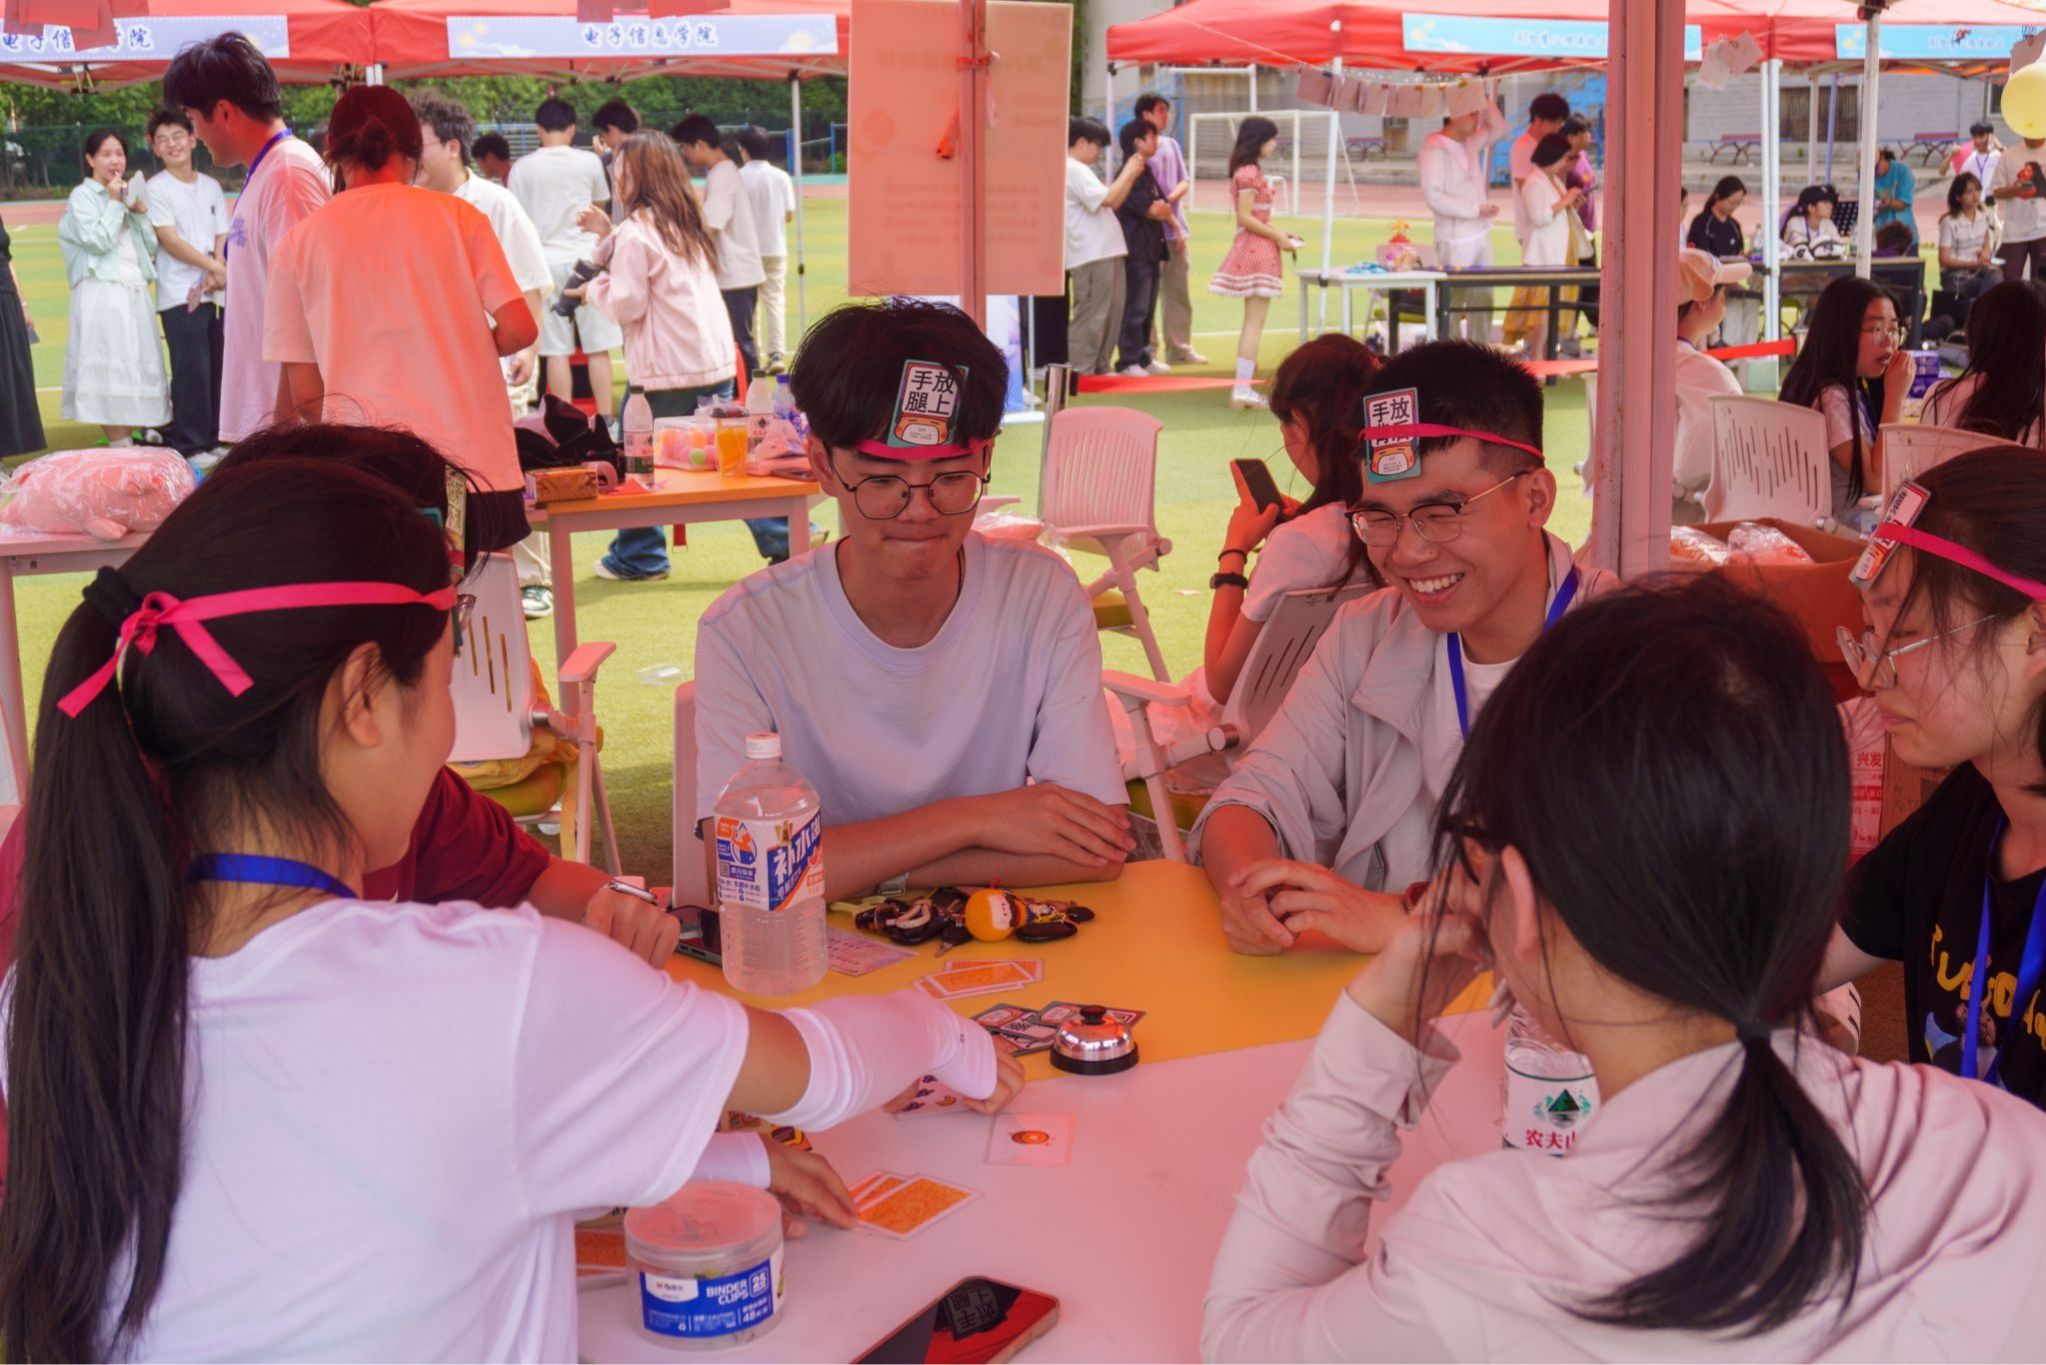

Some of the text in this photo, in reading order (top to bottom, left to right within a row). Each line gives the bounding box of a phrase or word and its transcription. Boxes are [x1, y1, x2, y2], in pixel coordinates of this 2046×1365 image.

[3, 28, 151, 49] 电子信院
[584, 23, 716, 46] 电子信息学院
[911, 370, 957, 394] 手放
[904, 391, 950, 416] 腿上
[1372, 397, 1410, 423] 手放
[706, 1278, 748, 1298] BINDER
[718, 1288, 749, 1305] CLIPS
